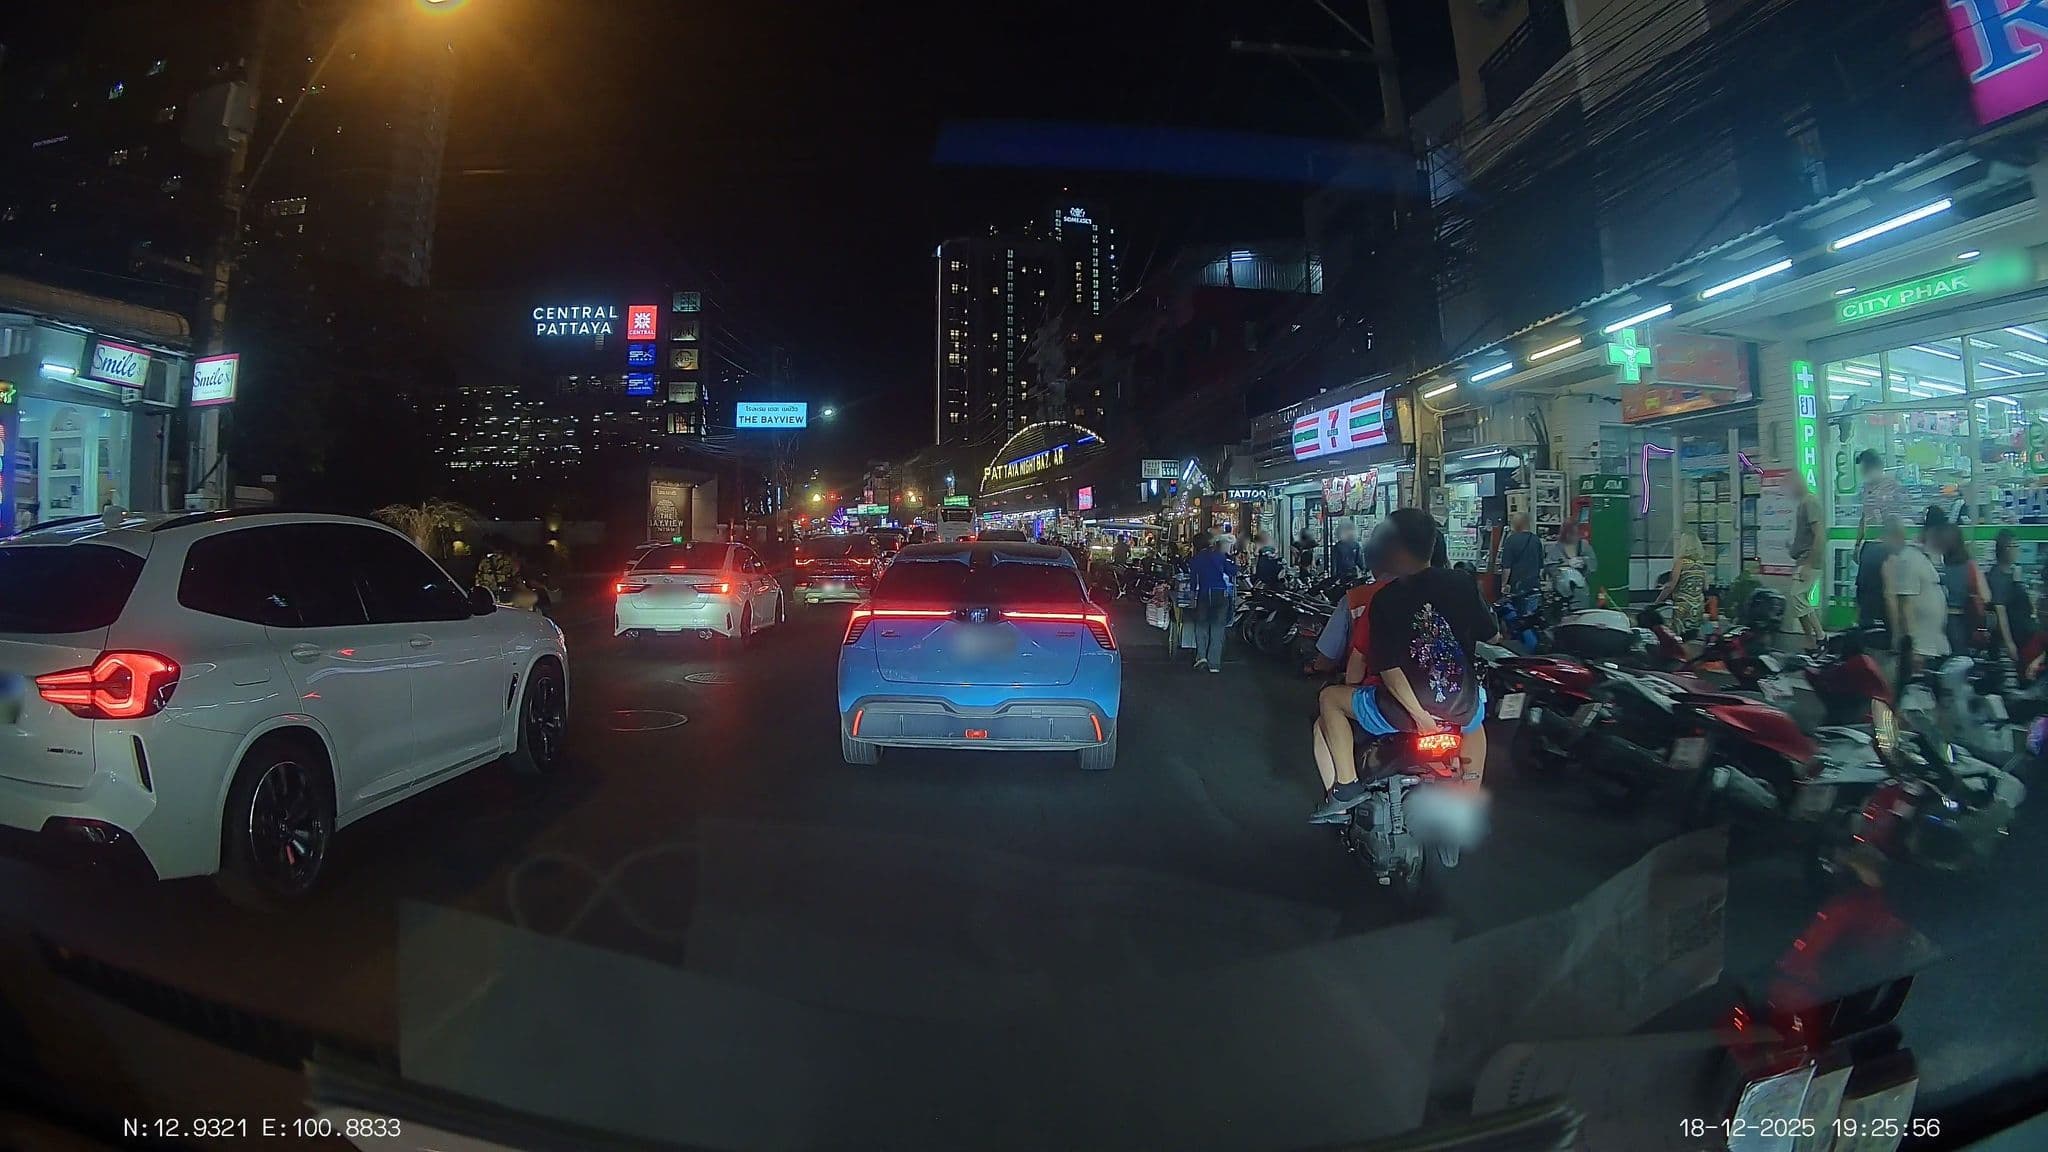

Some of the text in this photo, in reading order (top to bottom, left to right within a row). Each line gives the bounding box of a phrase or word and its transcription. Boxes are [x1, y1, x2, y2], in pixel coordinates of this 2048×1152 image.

[1842, 275, 1968, 318] CITY PHAR
[533, 305, 618, 320] CENTRAL
[536, 322, 612, 336] PATTAYA
[93, 346, 137, 378] Smile
[193, 367, 224, 387] Smile
[1800, 396, 1816, 416] ยา
[739, 415, 804, 424] THE BAYVIEW
[1804, 424, 1817, 487] PHA
[984, 463, 1020, 481] PATTAYA
[1228, 489, 1267, 499] TATTOO
